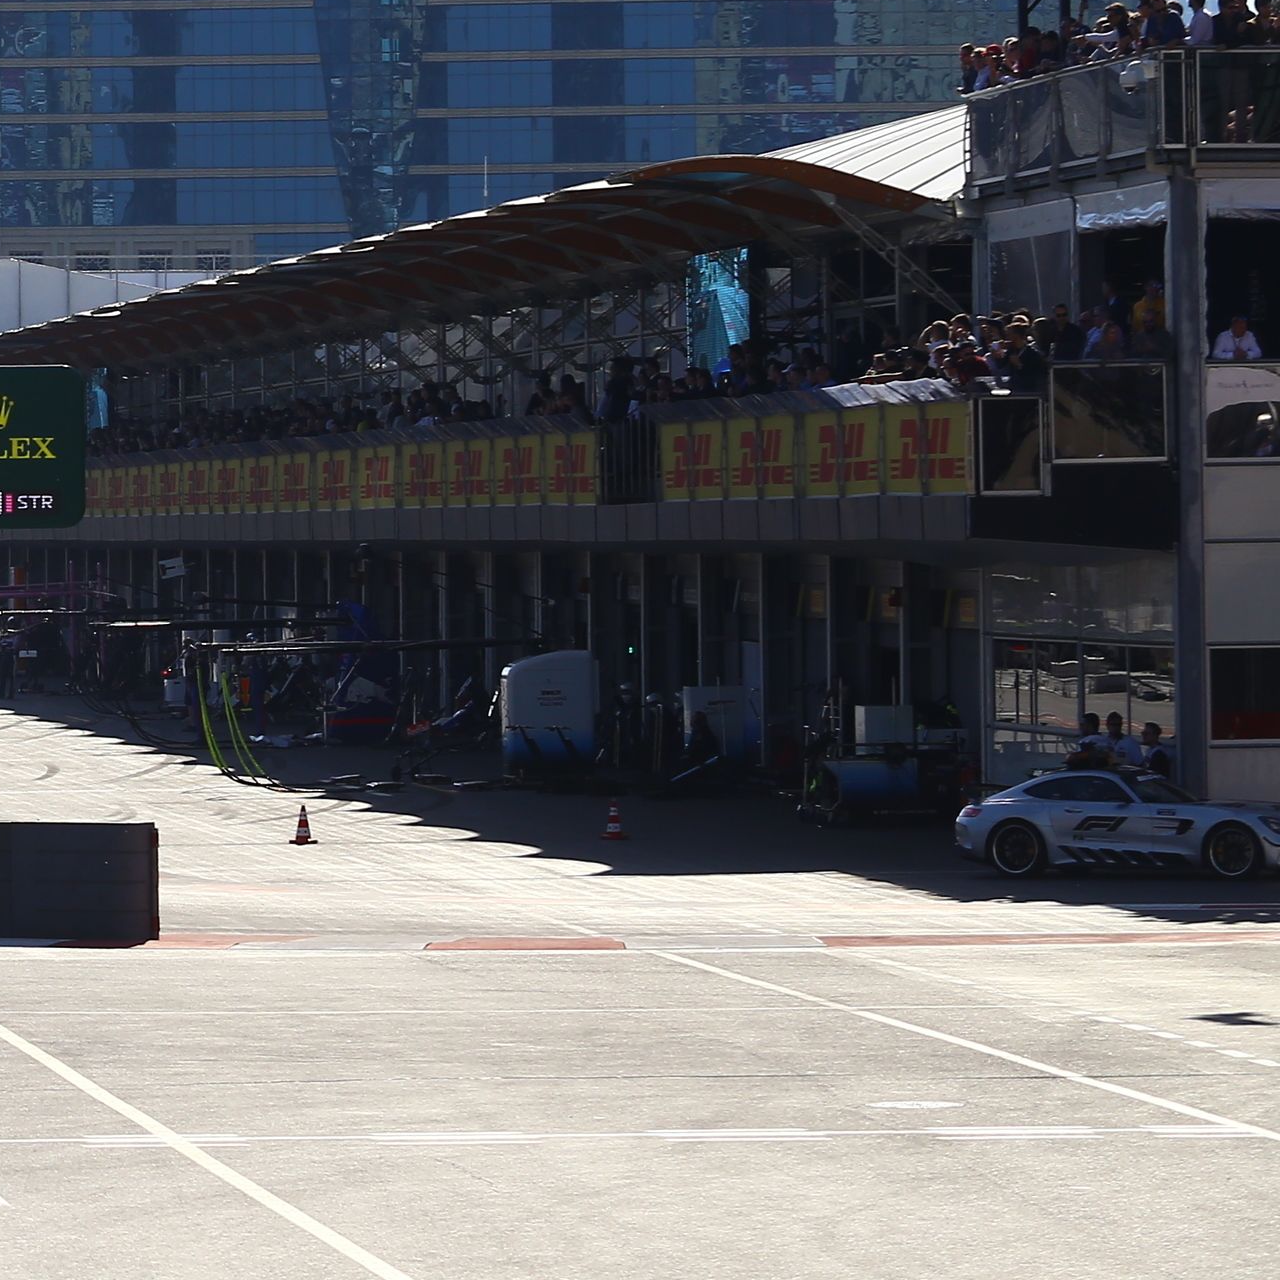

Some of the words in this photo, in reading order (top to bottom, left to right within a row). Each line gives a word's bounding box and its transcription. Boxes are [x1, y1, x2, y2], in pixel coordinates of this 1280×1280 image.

[818, 423, 869, 483] DHL
[900, 418, 957, 480] DHL
[17, 495, 53, 509] STR
[1071, 815, 1130, 832] F1
